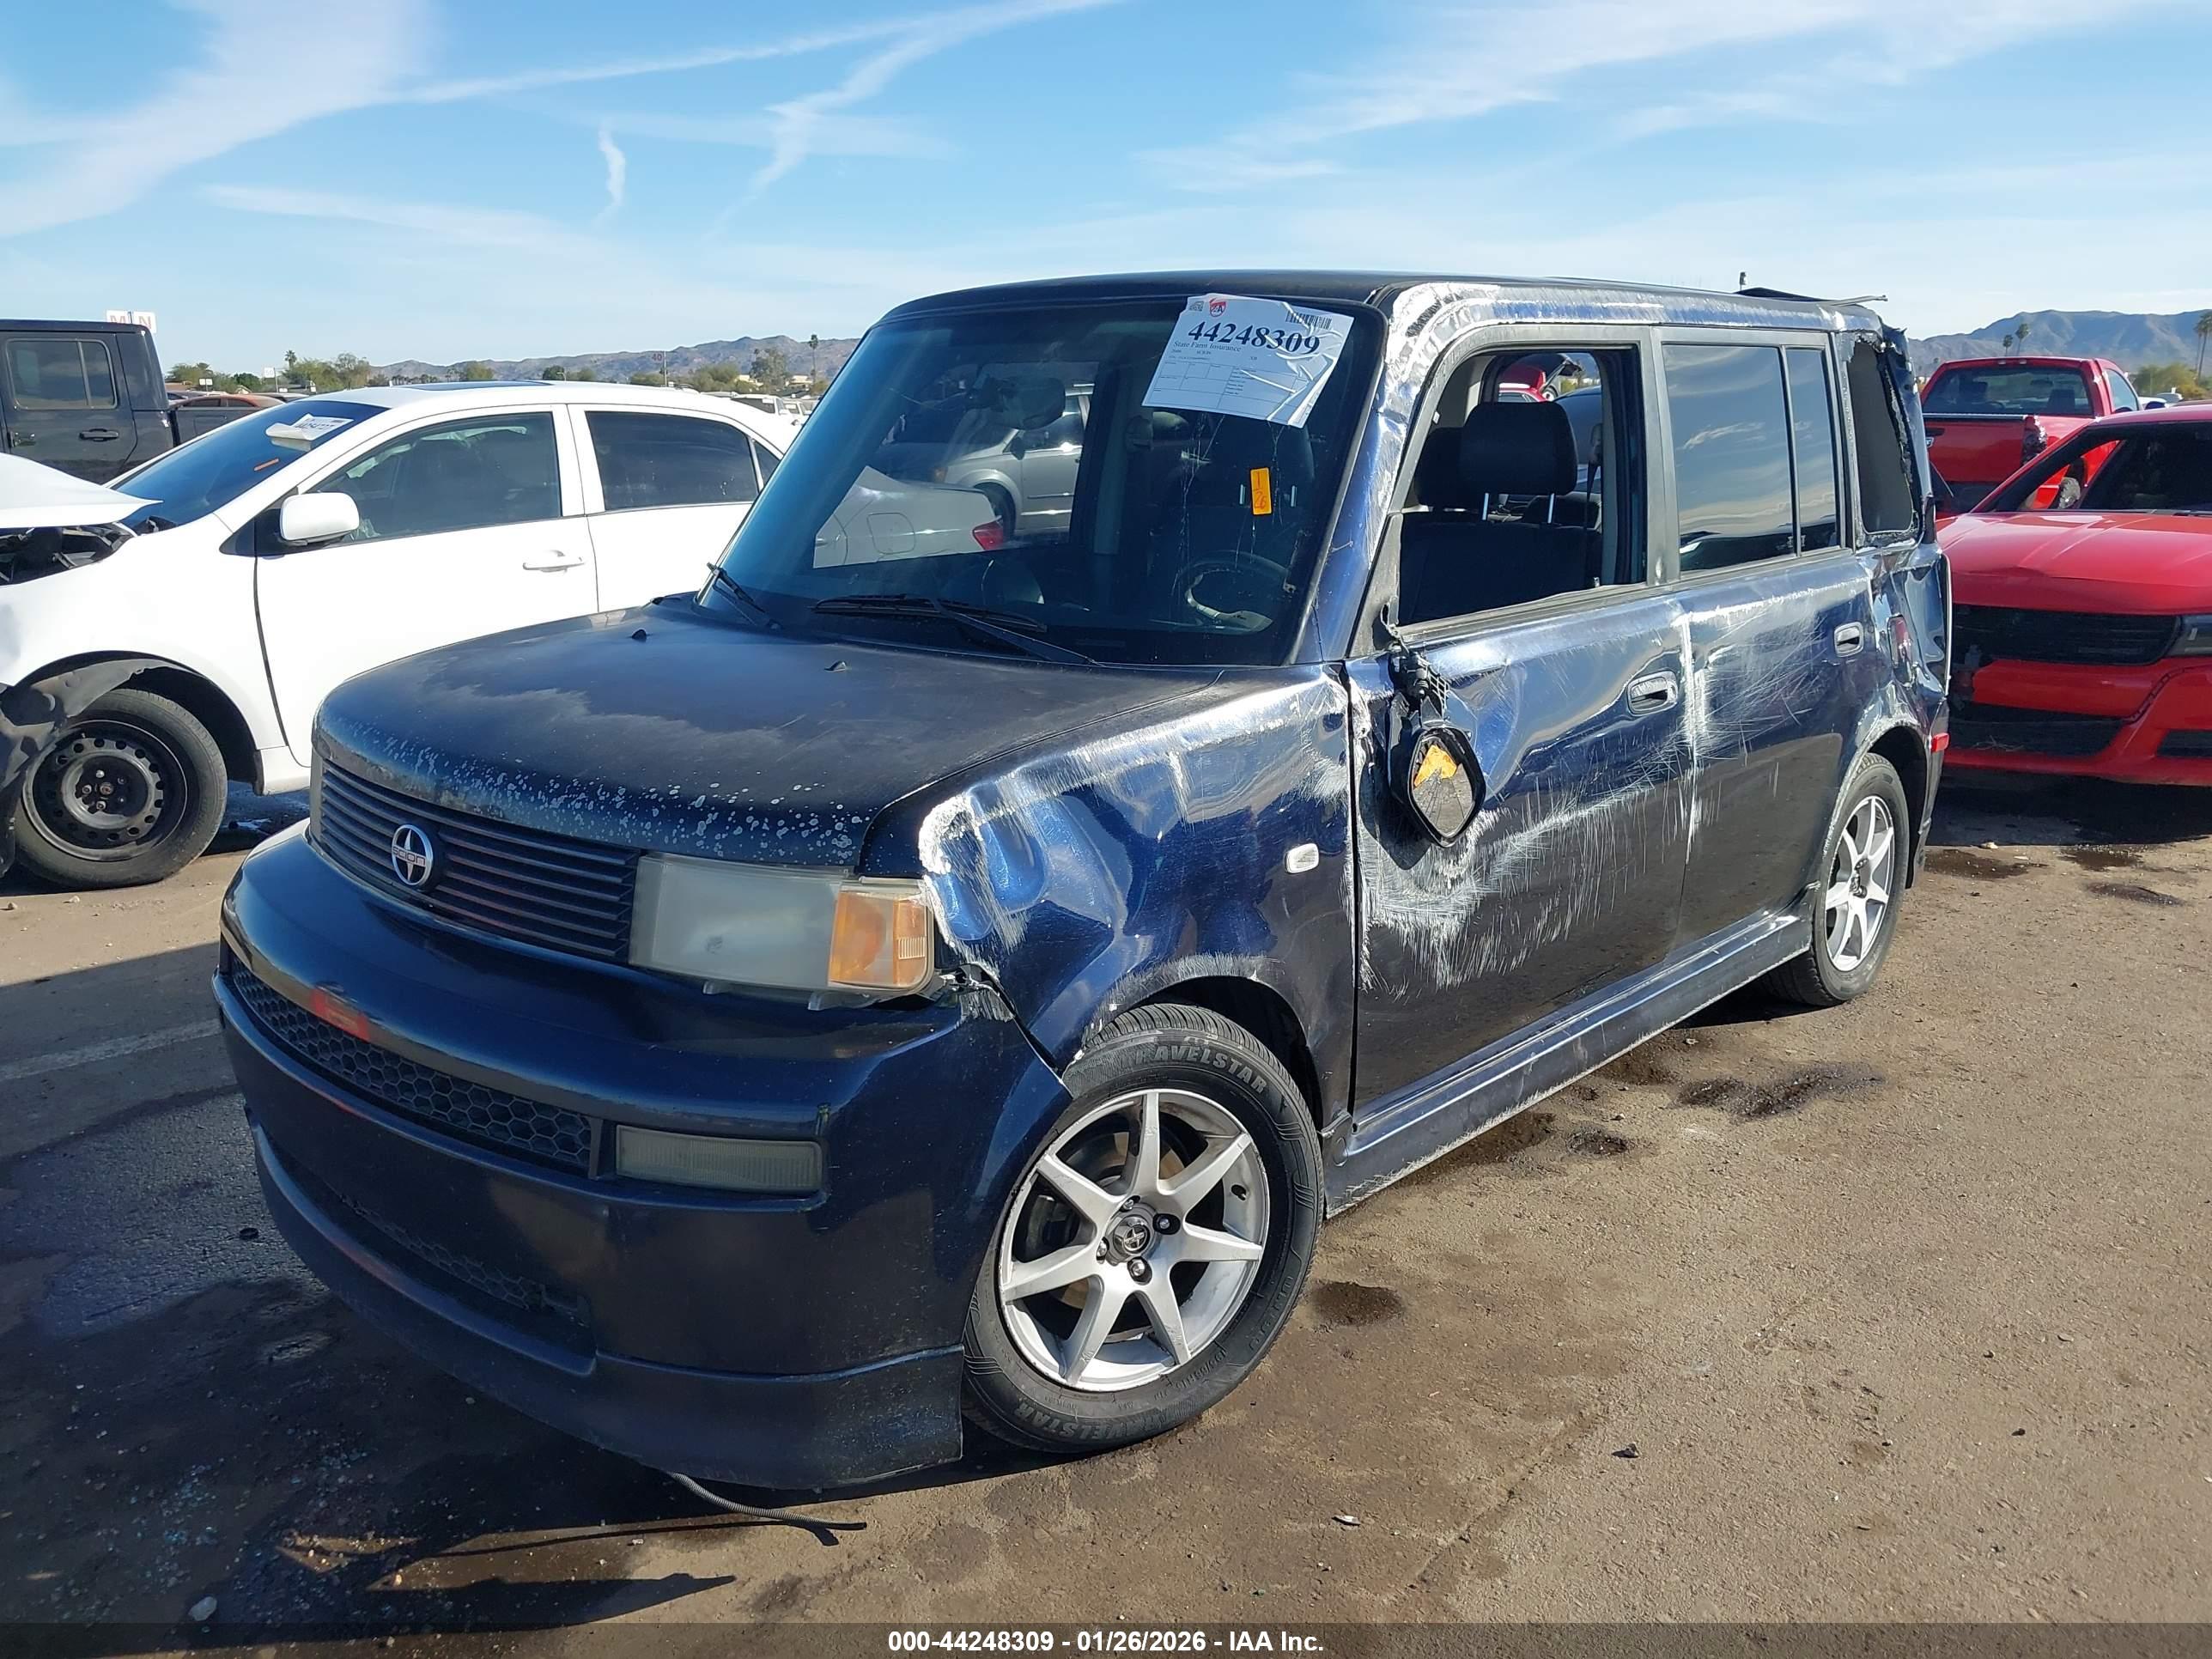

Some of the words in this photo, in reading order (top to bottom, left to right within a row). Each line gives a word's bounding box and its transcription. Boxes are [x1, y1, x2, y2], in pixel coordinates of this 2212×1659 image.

[138, 315, 152, 330] N
[1188, 321, 1320, 353] 44248309
[1191, 341, 1208, 349] Farm
[1209, 342, 1242, 352] Insurance
[392, 846, 426, 866] SCION
